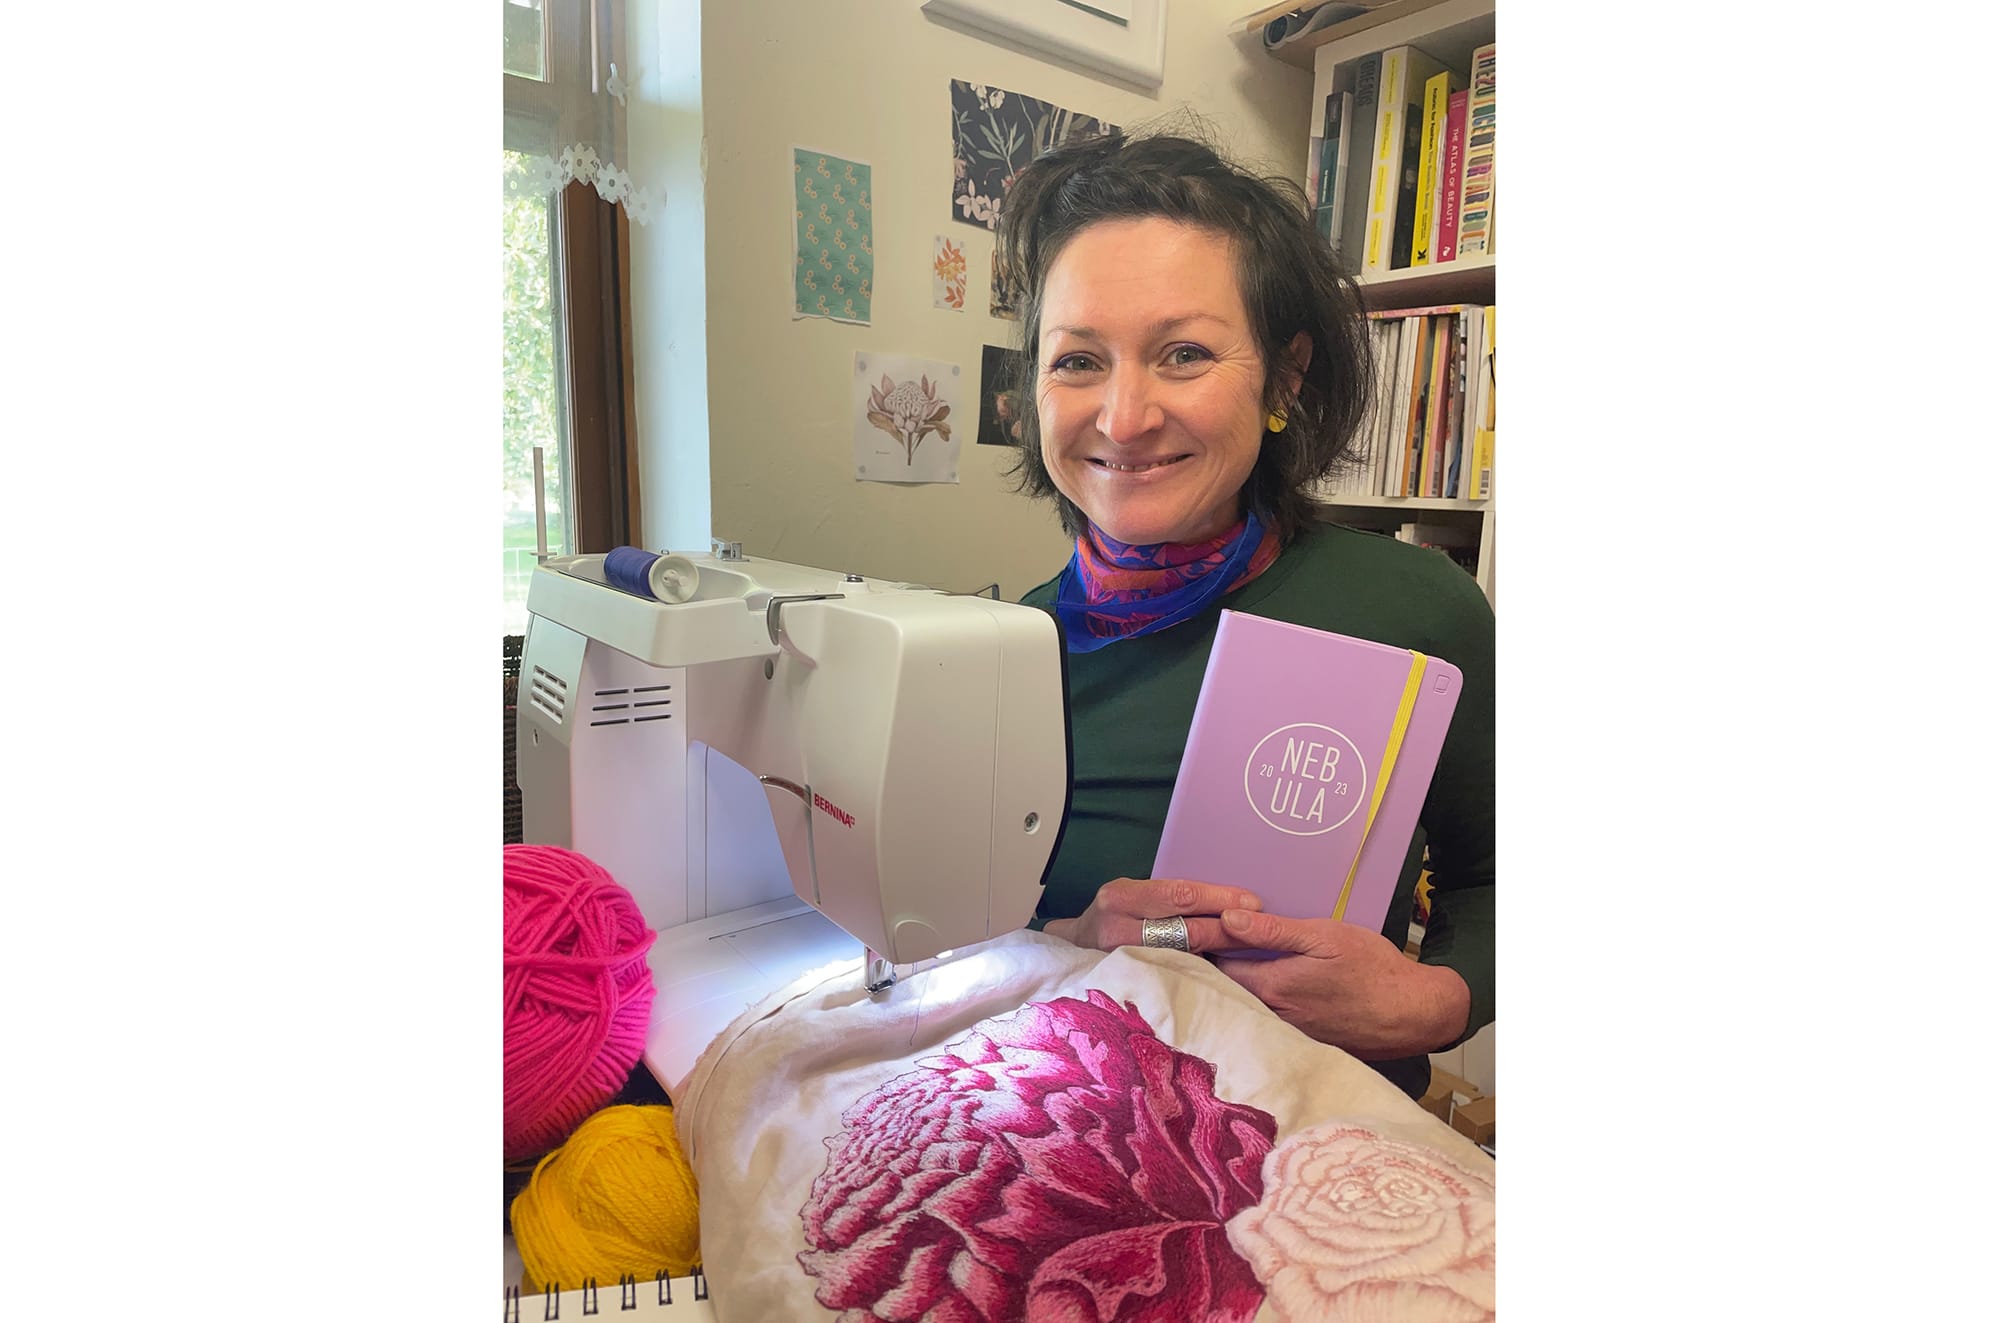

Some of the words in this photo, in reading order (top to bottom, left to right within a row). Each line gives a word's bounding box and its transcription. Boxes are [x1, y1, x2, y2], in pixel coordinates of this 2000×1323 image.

[1451, 128, 1459, 143] THE
[1449, 145, 1458, 174] ATLAS
[1448, 177, 1455, 188] OF
[1445, 190, 1455, 228] BEAUTY
[1280, 737, 1341, 783] NEB
[1259, 763, 1274, 778] 20
[1334, 782, 1348, 796] 23
[814, 793, 852, 829] BERNINA
[1270, 777, 1325, 824] ULA
